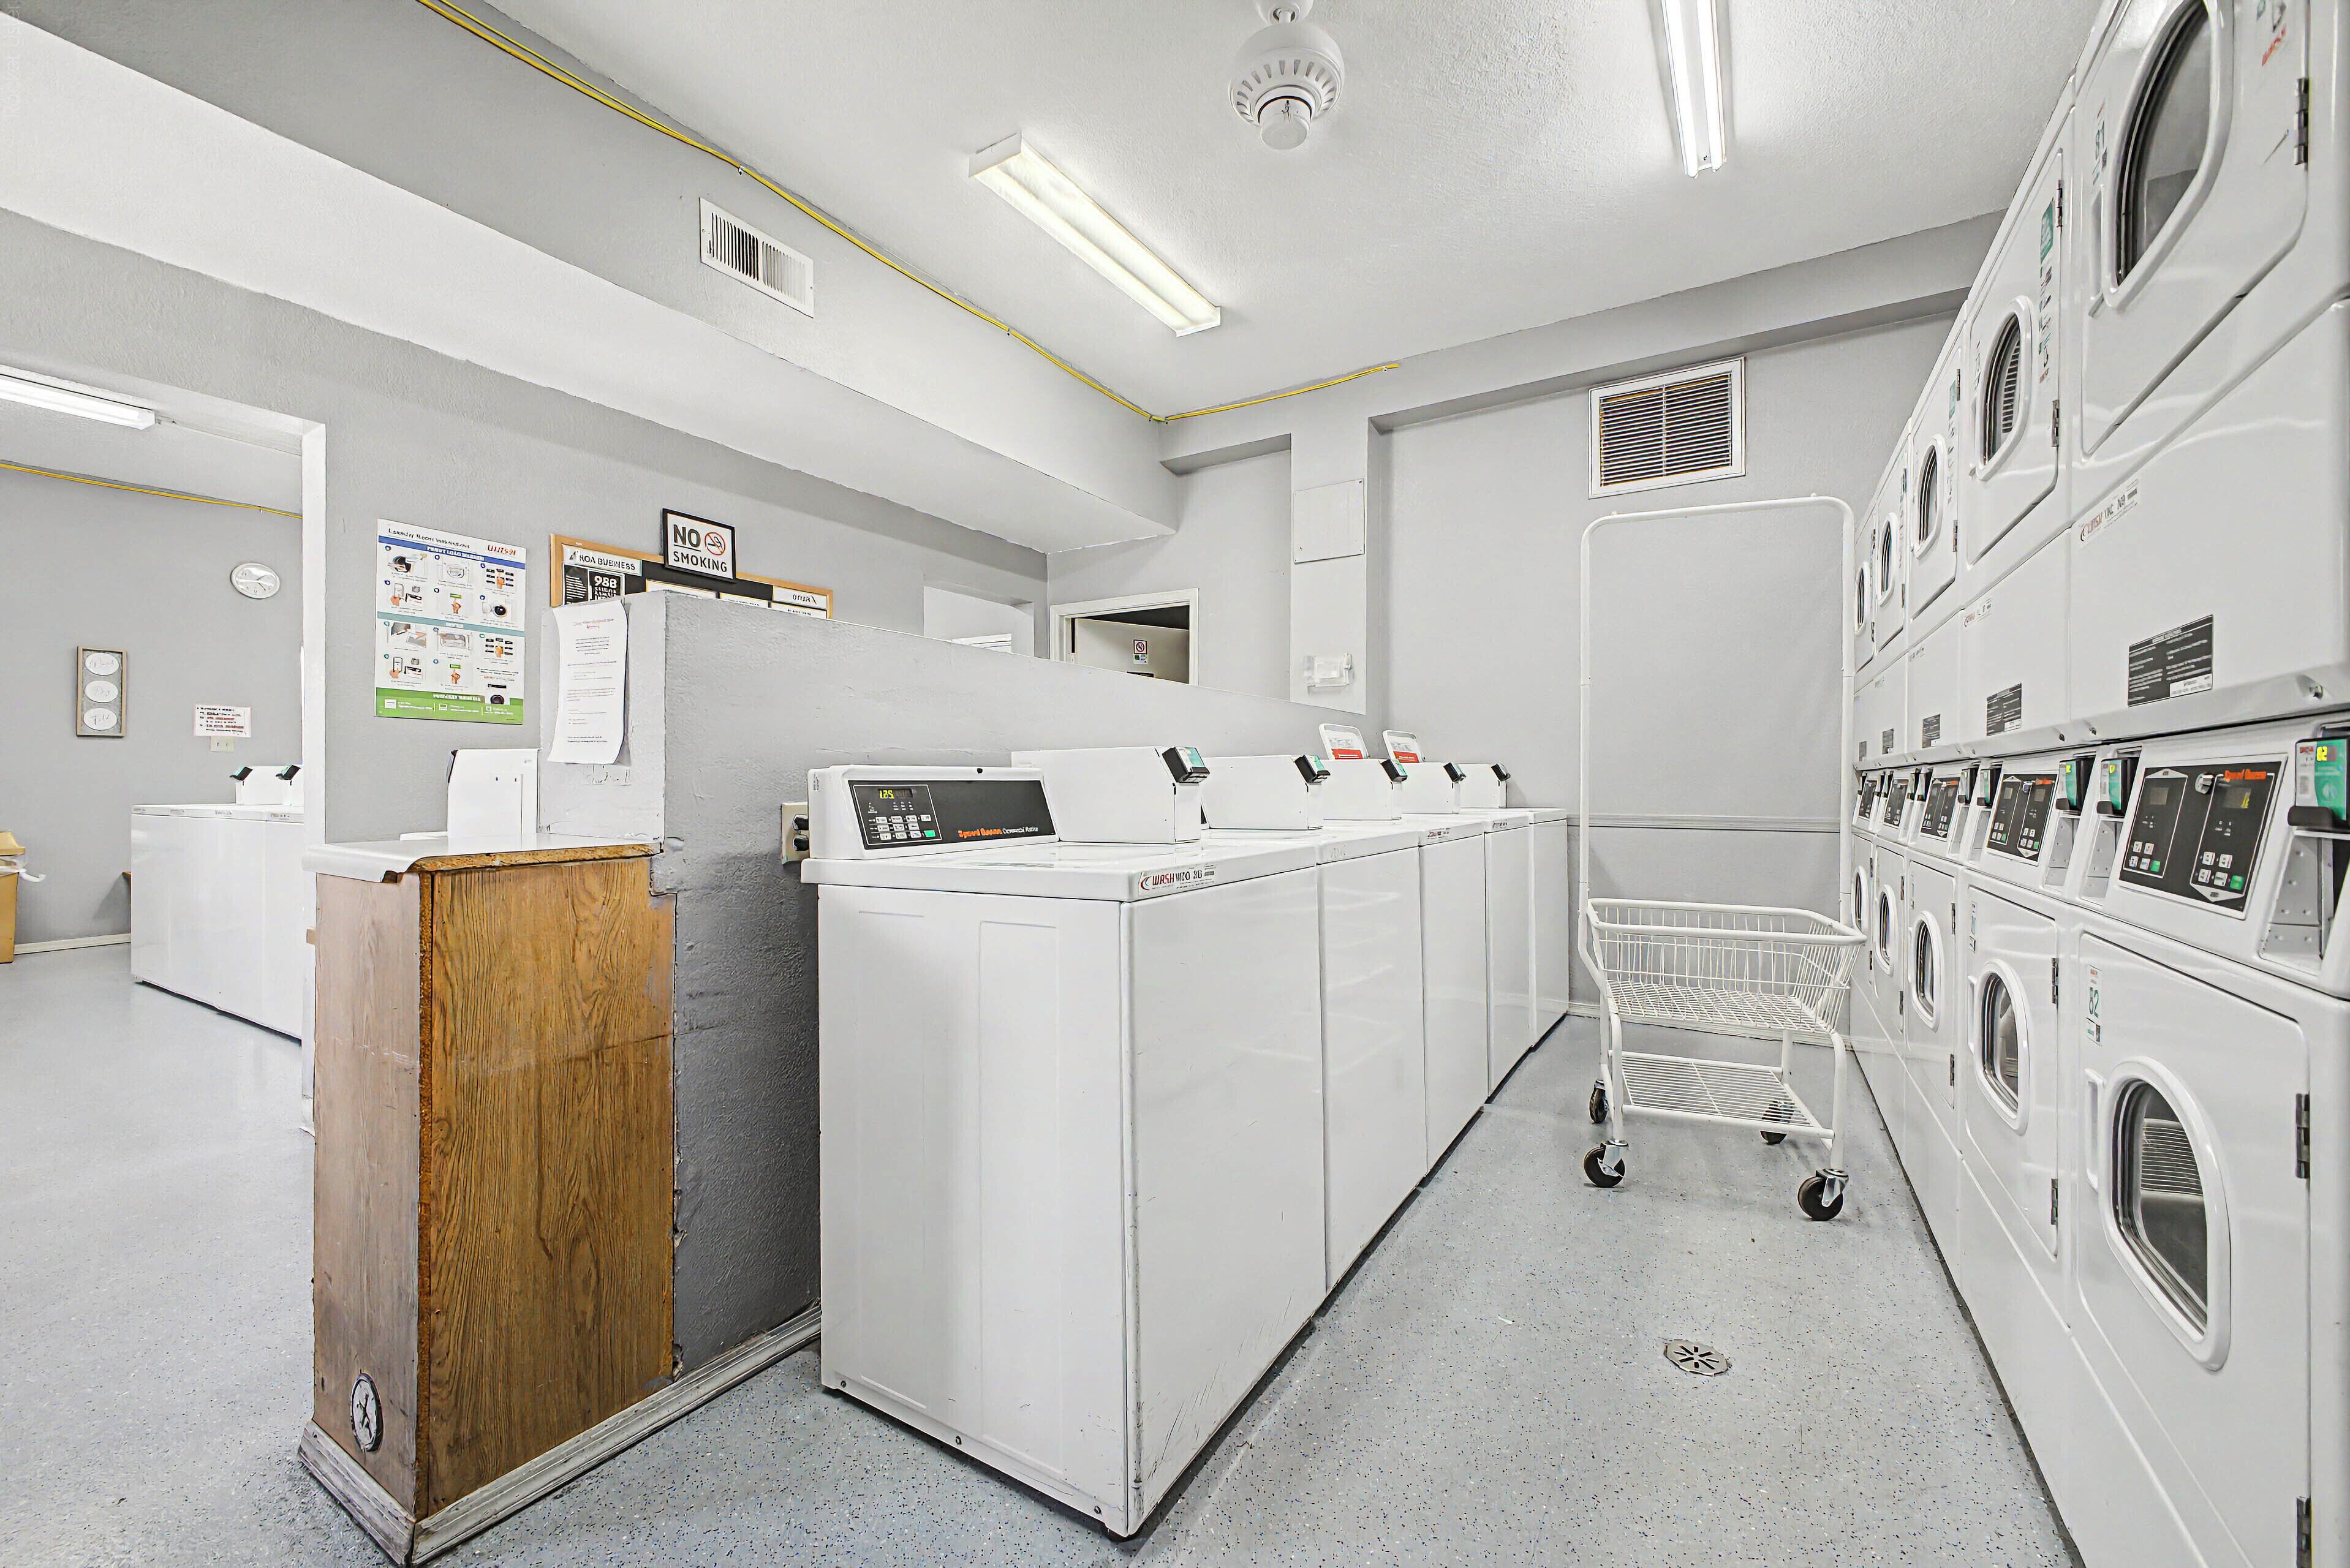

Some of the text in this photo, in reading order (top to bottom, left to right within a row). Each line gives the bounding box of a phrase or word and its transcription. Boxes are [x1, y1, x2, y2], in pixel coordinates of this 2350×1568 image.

[673, 524, 701, 548] NO
[673, 551, 727, 573] SMOKING
[594, 575, 618, 589] 988
[1152, 873, 1174, 886] WASH
